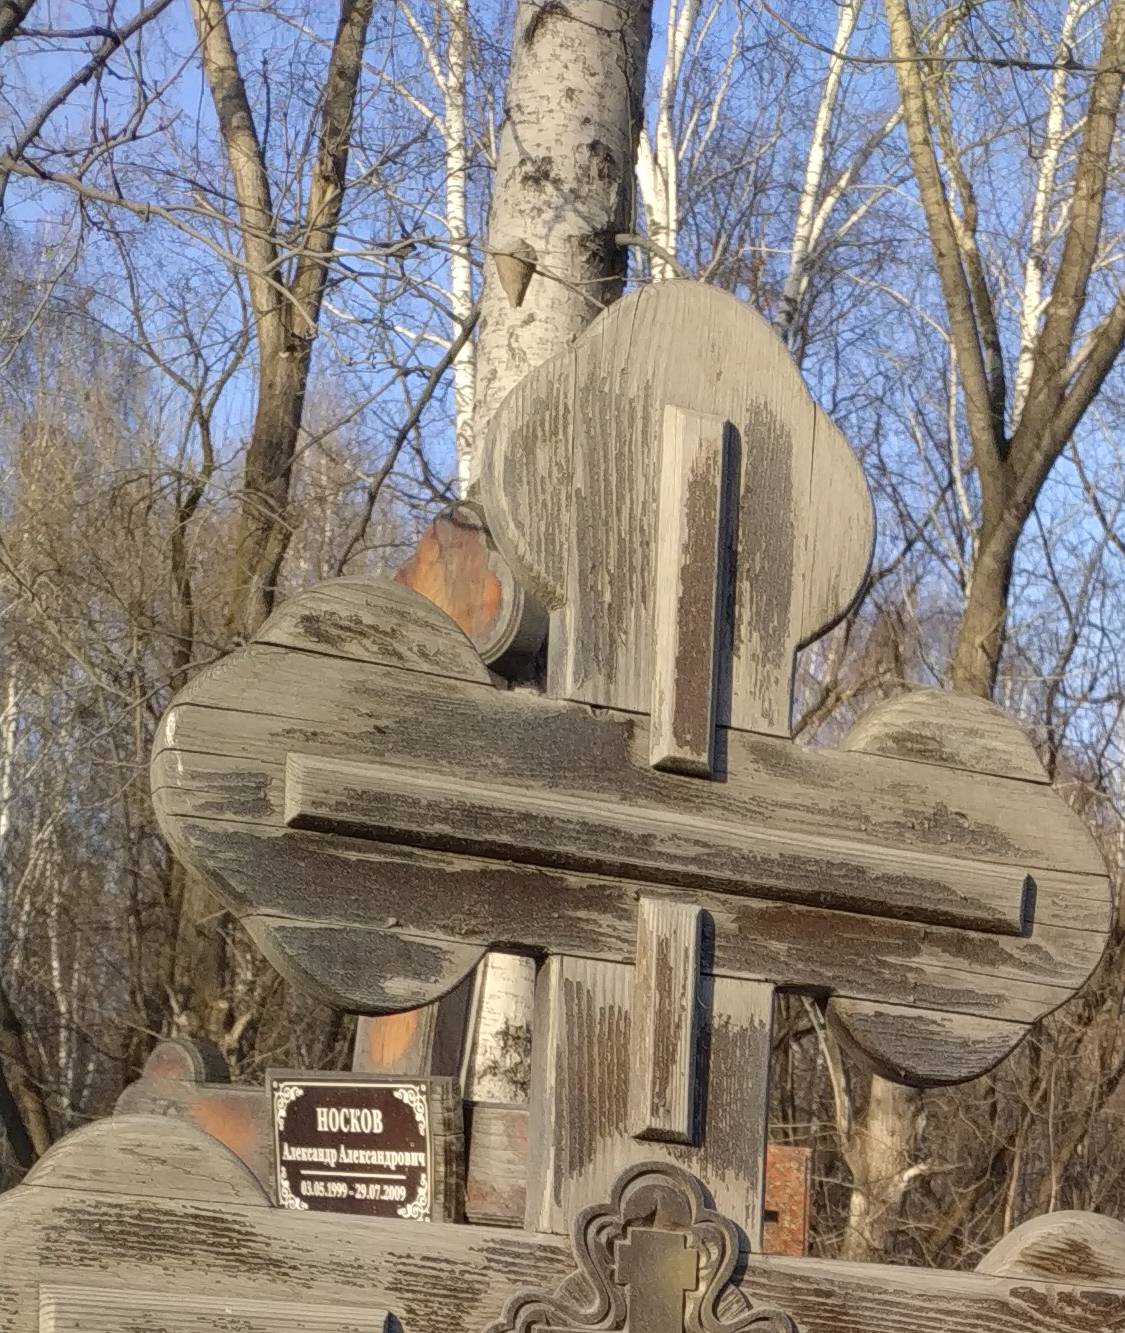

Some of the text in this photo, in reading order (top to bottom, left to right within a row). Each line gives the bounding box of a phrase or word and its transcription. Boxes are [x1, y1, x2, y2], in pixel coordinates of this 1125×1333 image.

[315, 1107, 384, 1134] НОСКОВ
[281, 1142, 426, 1170] Александр Александрович
[354, 1184, 407, 1202] 29.07.2009
